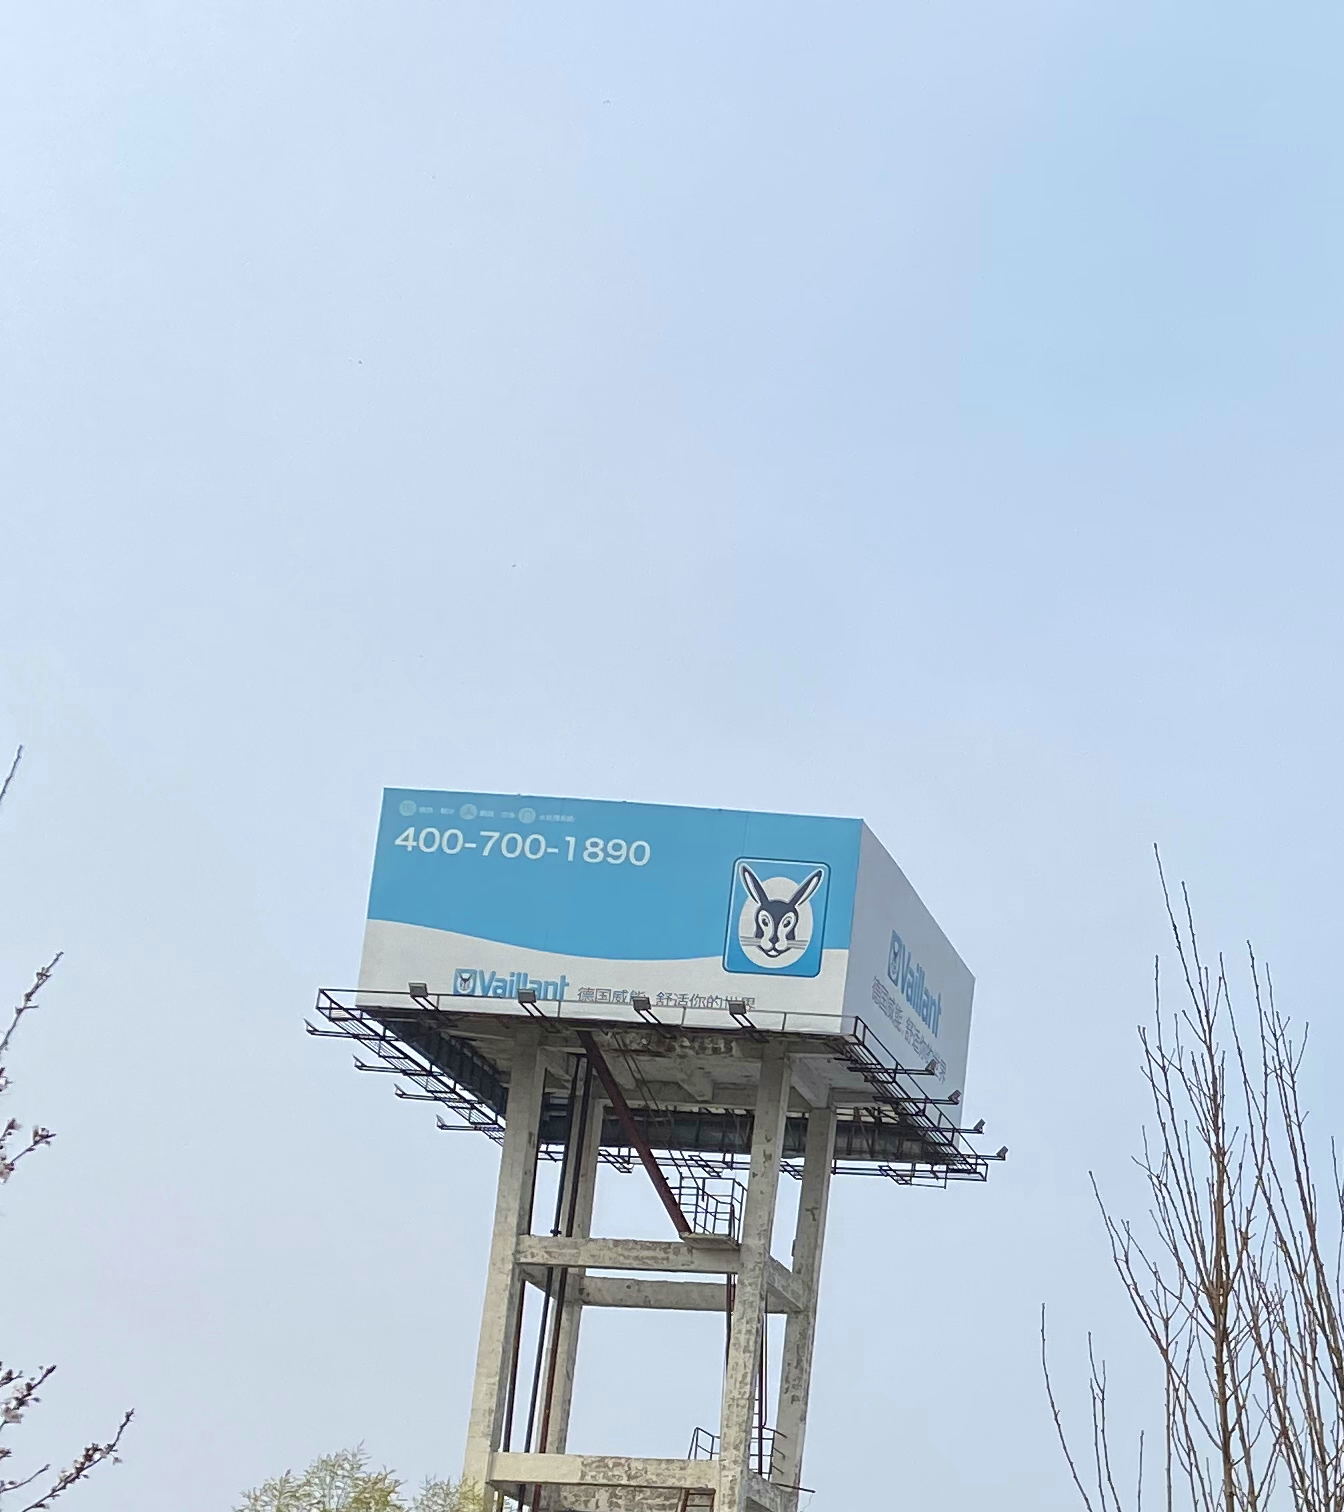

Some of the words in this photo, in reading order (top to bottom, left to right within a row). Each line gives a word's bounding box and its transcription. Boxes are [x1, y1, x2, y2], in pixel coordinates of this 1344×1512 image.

[394, 826, 651, 866] 400-700-1890
[479, 969, 569, 1000] Vaillant
[901, 944, 942, 1038] Vaillant
